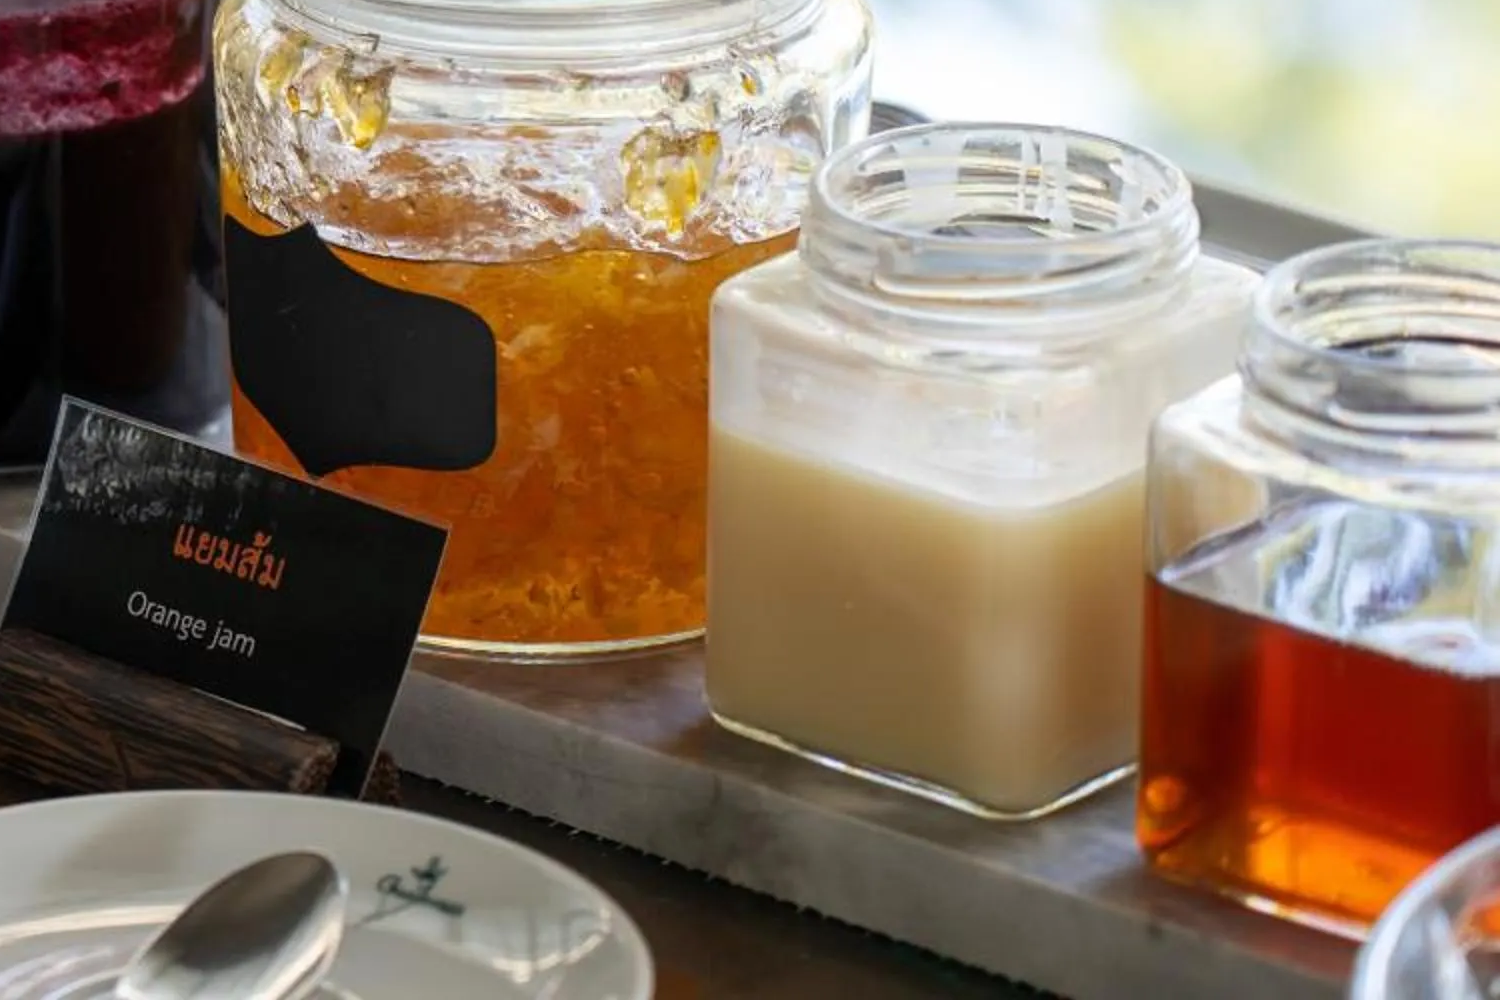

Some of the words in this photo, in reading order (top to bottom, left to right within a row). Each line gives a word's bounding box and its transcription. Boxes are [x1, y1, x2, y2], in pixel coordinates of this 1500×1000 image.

[173, 523, 286, 590] แยมส้ม
[127, 591, 207, 640] Orange
[207, 620, 256, 657] jam
